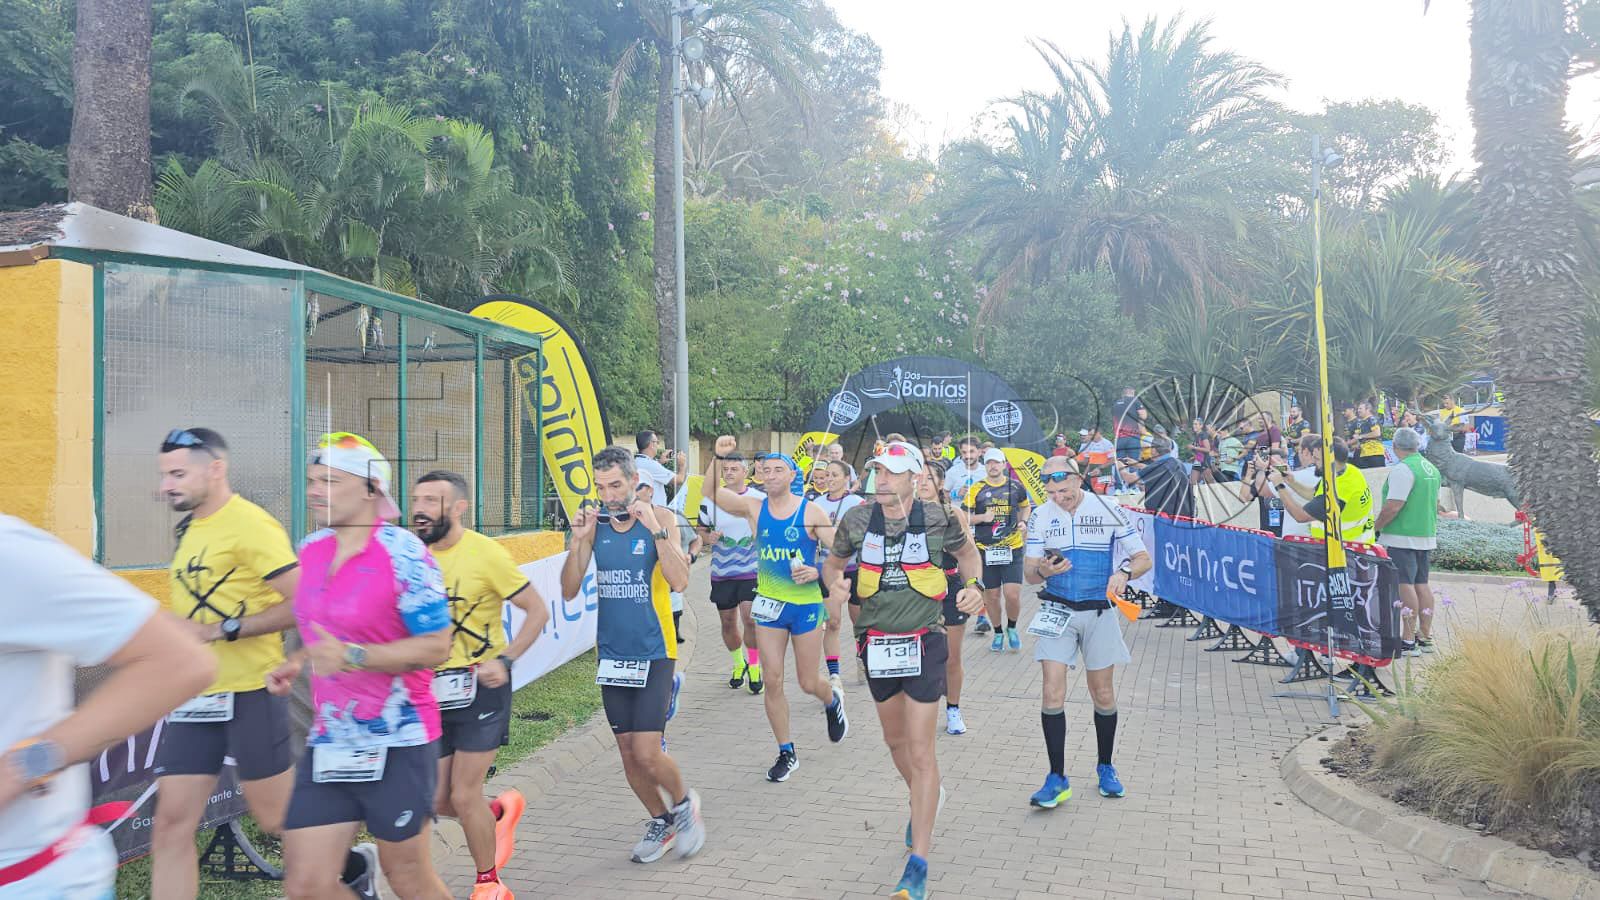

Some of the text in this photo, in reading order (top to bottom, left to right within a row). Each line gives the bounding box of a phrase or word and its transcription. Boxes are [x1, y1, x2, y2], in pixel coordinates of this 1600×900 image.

[904, 371, 920, 379] Dos
[902, 379, 967, 398] Bahías
[1045, 526, 1067, 538] CYCLE
